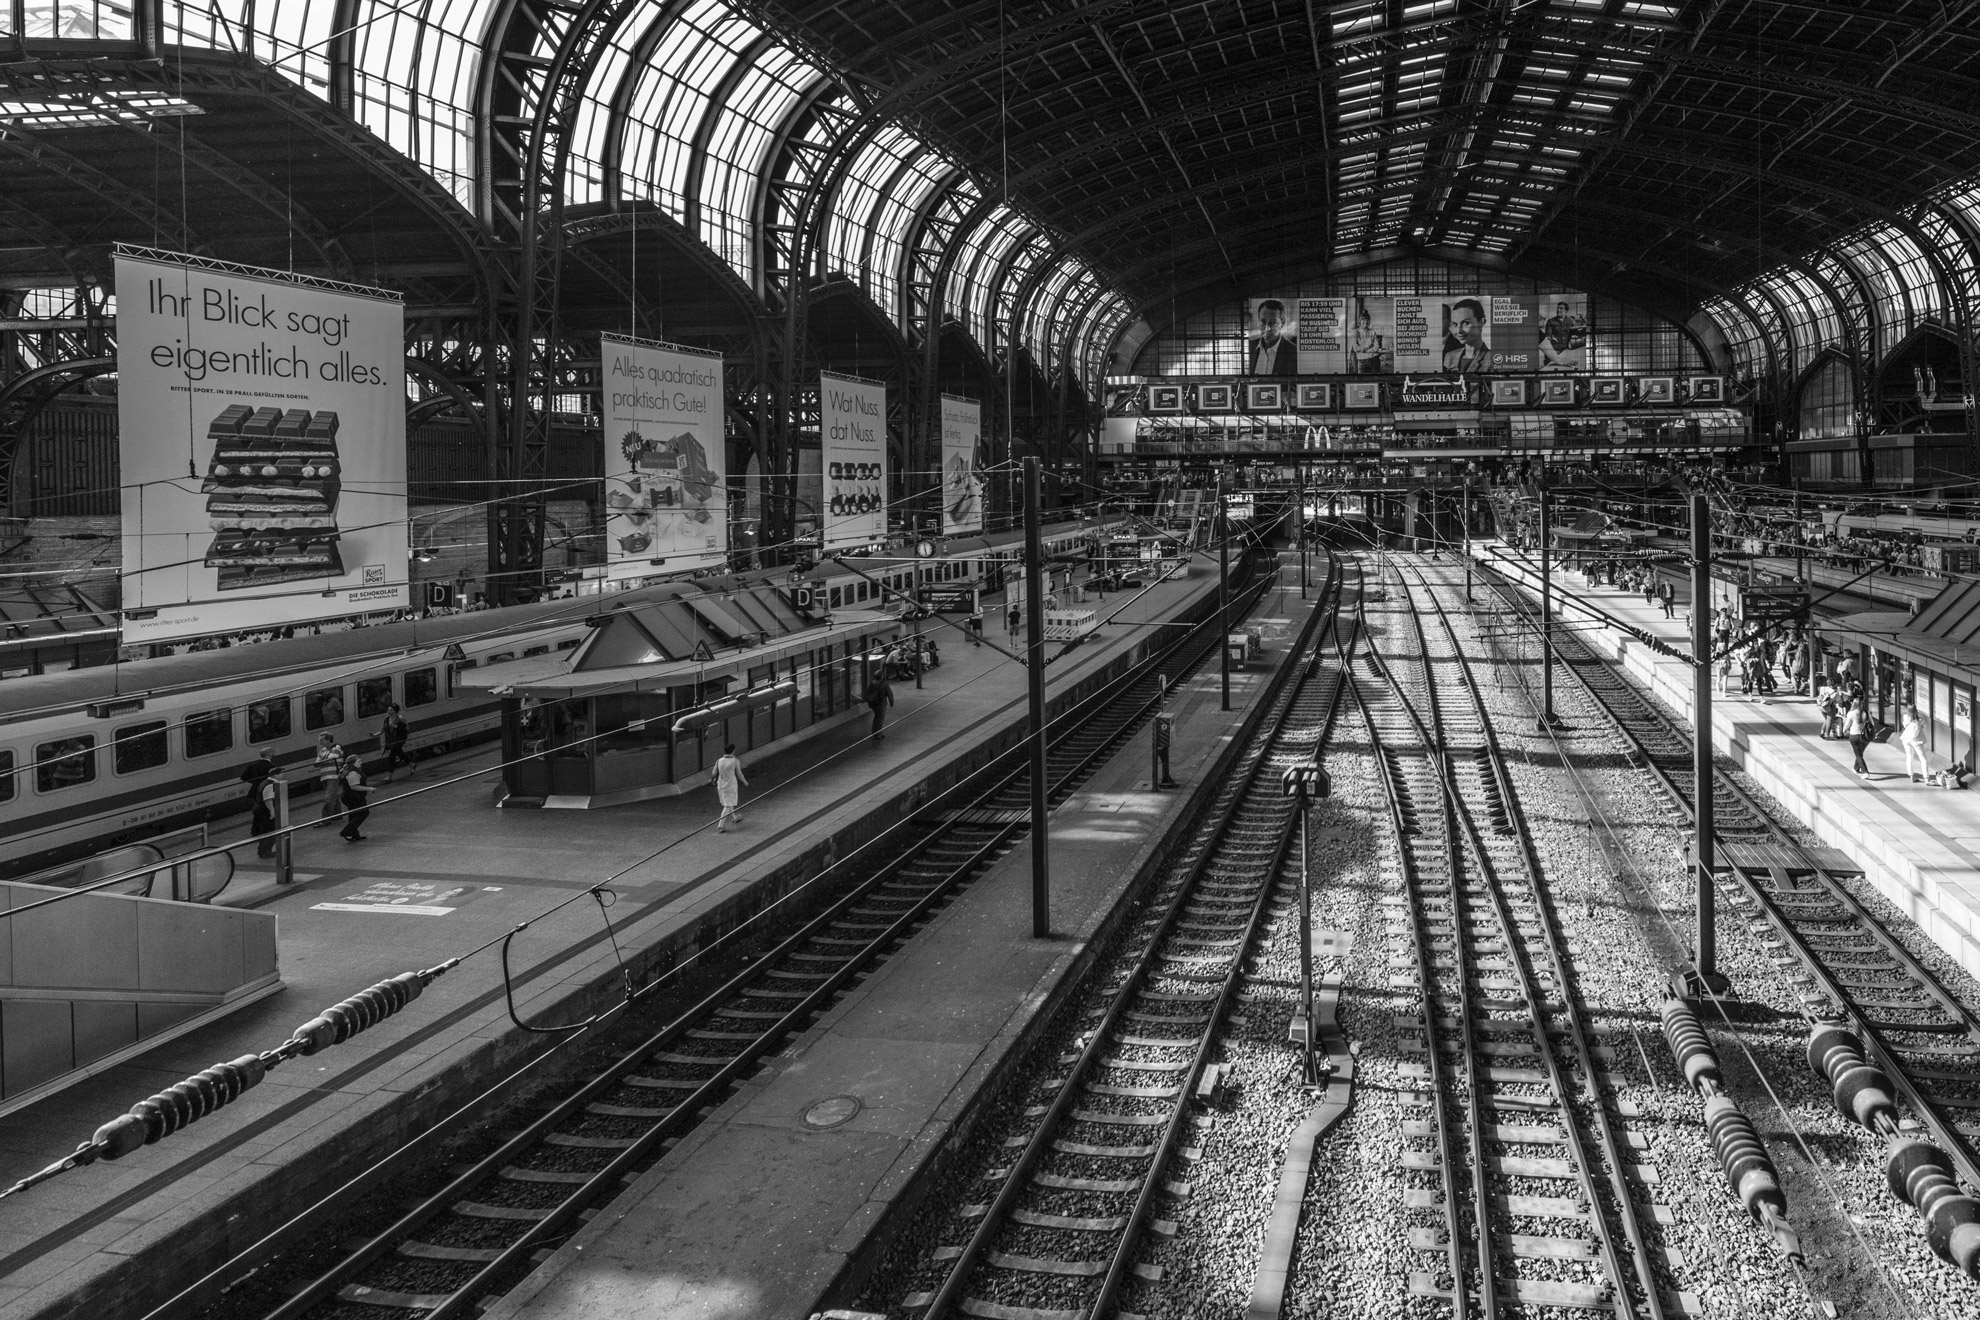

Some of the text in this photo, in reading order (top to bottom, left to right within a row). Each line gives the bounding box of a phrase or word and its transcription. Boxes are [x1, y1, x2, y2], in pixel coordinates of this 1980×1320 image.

[149, 277, 351, 346] Ihr Blick sagt
[150, 338, 388, 387] eigentlich alles.
[1505, 354, 1528, 363] HRS
[611, 356, 717, 388] Alles quadratisch
[253, 391, 285, 399] GEFÜLLTEN
[612, 386, 707, 413] praktisch Gute!
[1402, 393, 1468, 403] WANDELHALLE
[829, 389, 880, 420] Wat Nuss,
[830, 417, 876, 442] dat Nuss.
[625, 442, 642, 454] NEU
[364, 568, 383, 578] Ritter
[359, 588, 399, 598] SCHOKOLADE
[433, 586, 446, 602] D
[797, 588, 810, 606] D
[139, 616, 200, 629] www.ritter-sport.de
